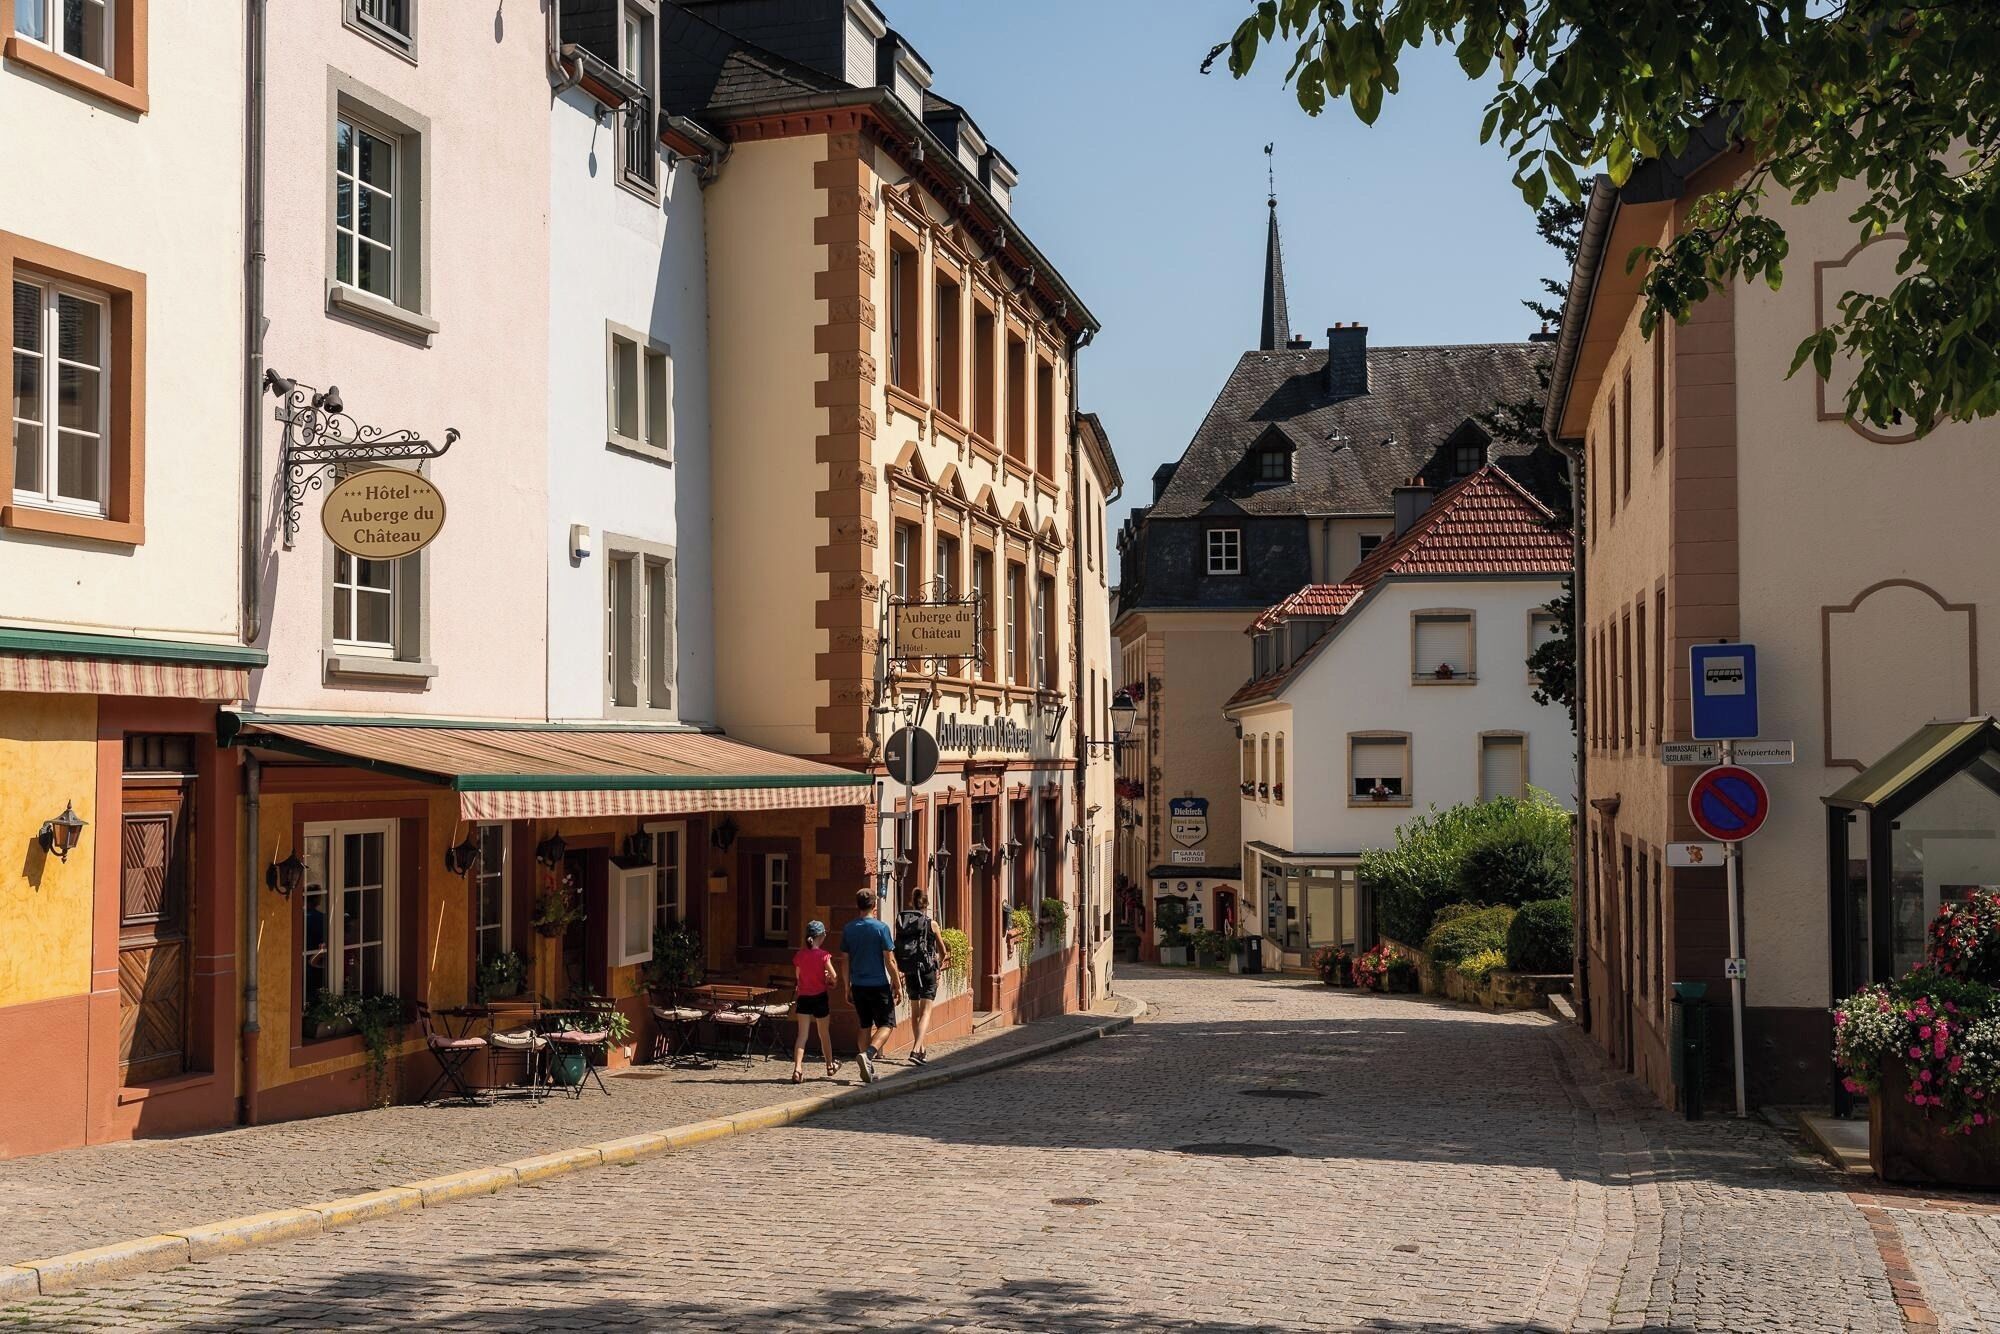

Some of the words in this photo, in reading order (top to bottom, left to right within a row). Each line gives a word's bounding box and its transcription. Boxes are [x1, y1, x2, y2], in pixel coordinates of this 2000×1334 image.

[366, 485, 410, 500] Hôtel
[341, 507, 409, 525] Auberge
[414, 506, 434, 521] du
[353, 529, 421, 544] Château
[902, 611, 952, 625] Auberge
[955, 610, 970, 622] du
[911, 626, 961, 640] Château
[936, 712, 984, 755] Auberge
[984, 715, 997, 748] du
[997, 716, 1033, 751] Château
[1665, 745, 1698, 753] RAMASSAGE
[1665, 754, 1693, 762] SCOLAIRE
[1174, 807, 1203, 816] Diekirch
